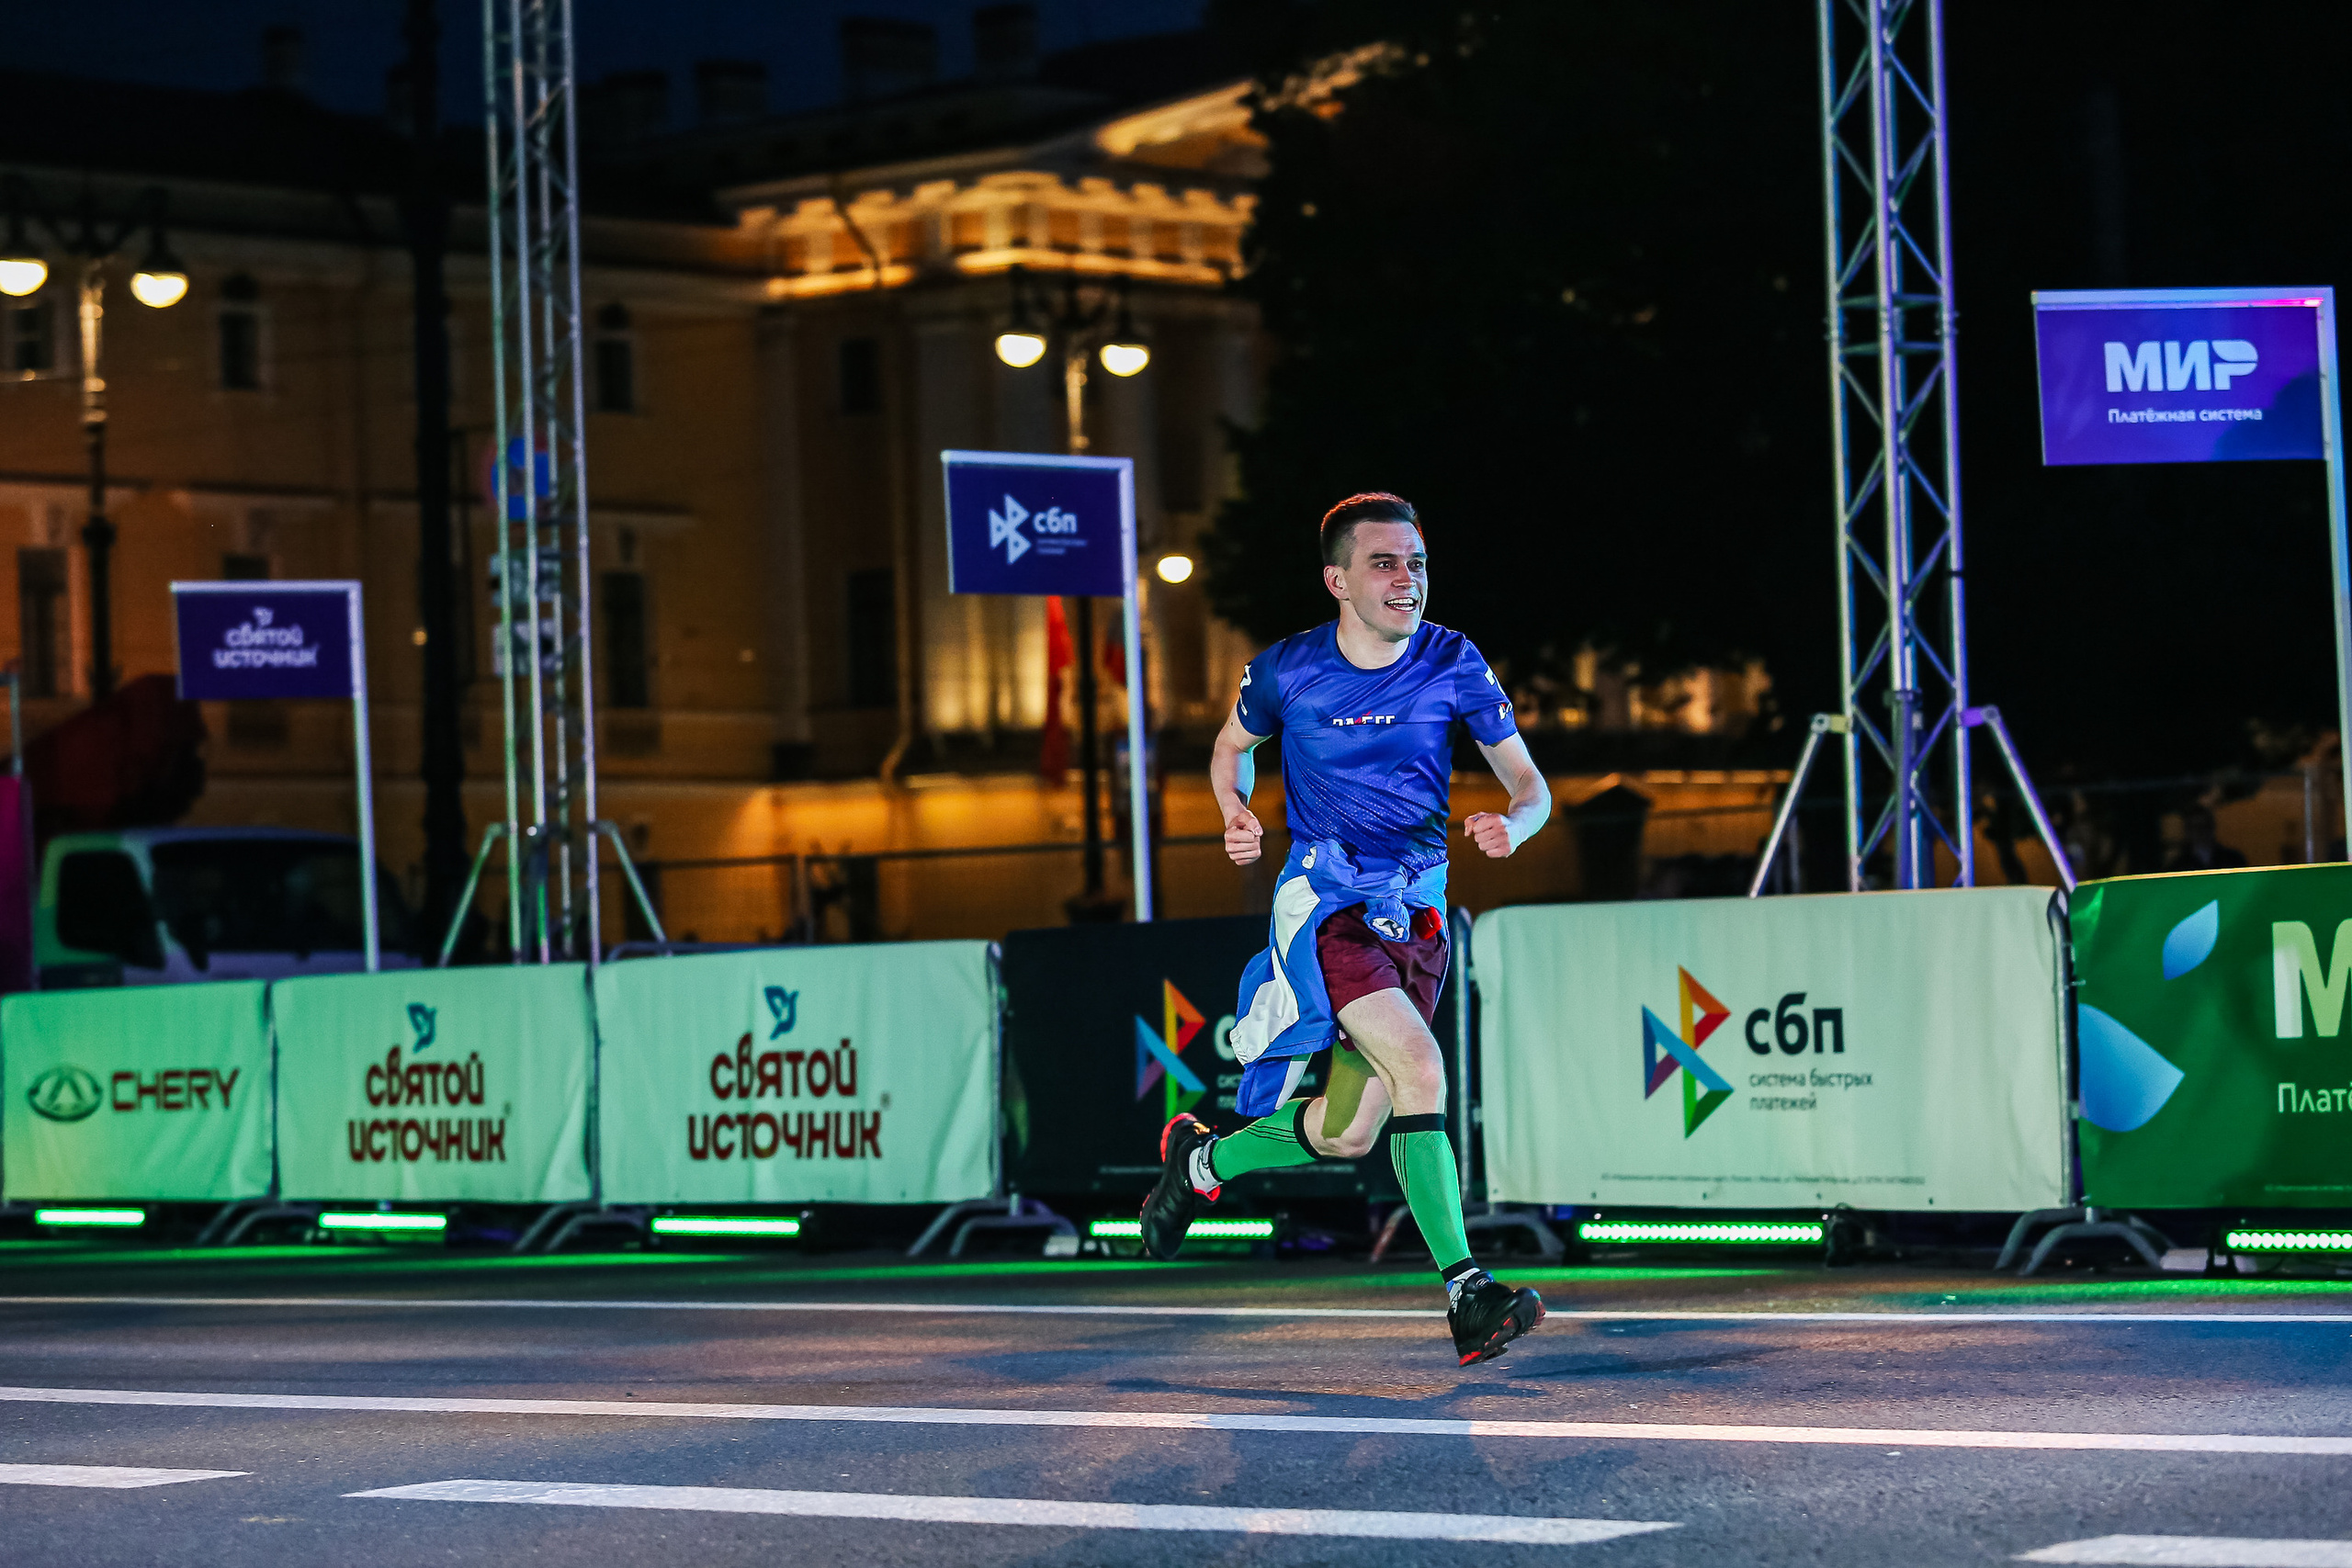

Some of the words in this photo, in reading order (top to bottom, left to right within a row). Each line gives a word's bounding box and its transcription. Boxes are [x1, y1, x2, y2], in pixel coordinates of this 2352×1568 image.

[2104, 339, 2258, 392] МИР
[2108, 407, 2197, 423] Платёжная
[2199, 409, 2263, 422] система
[111, 1068, 240, 1111] CHERY
